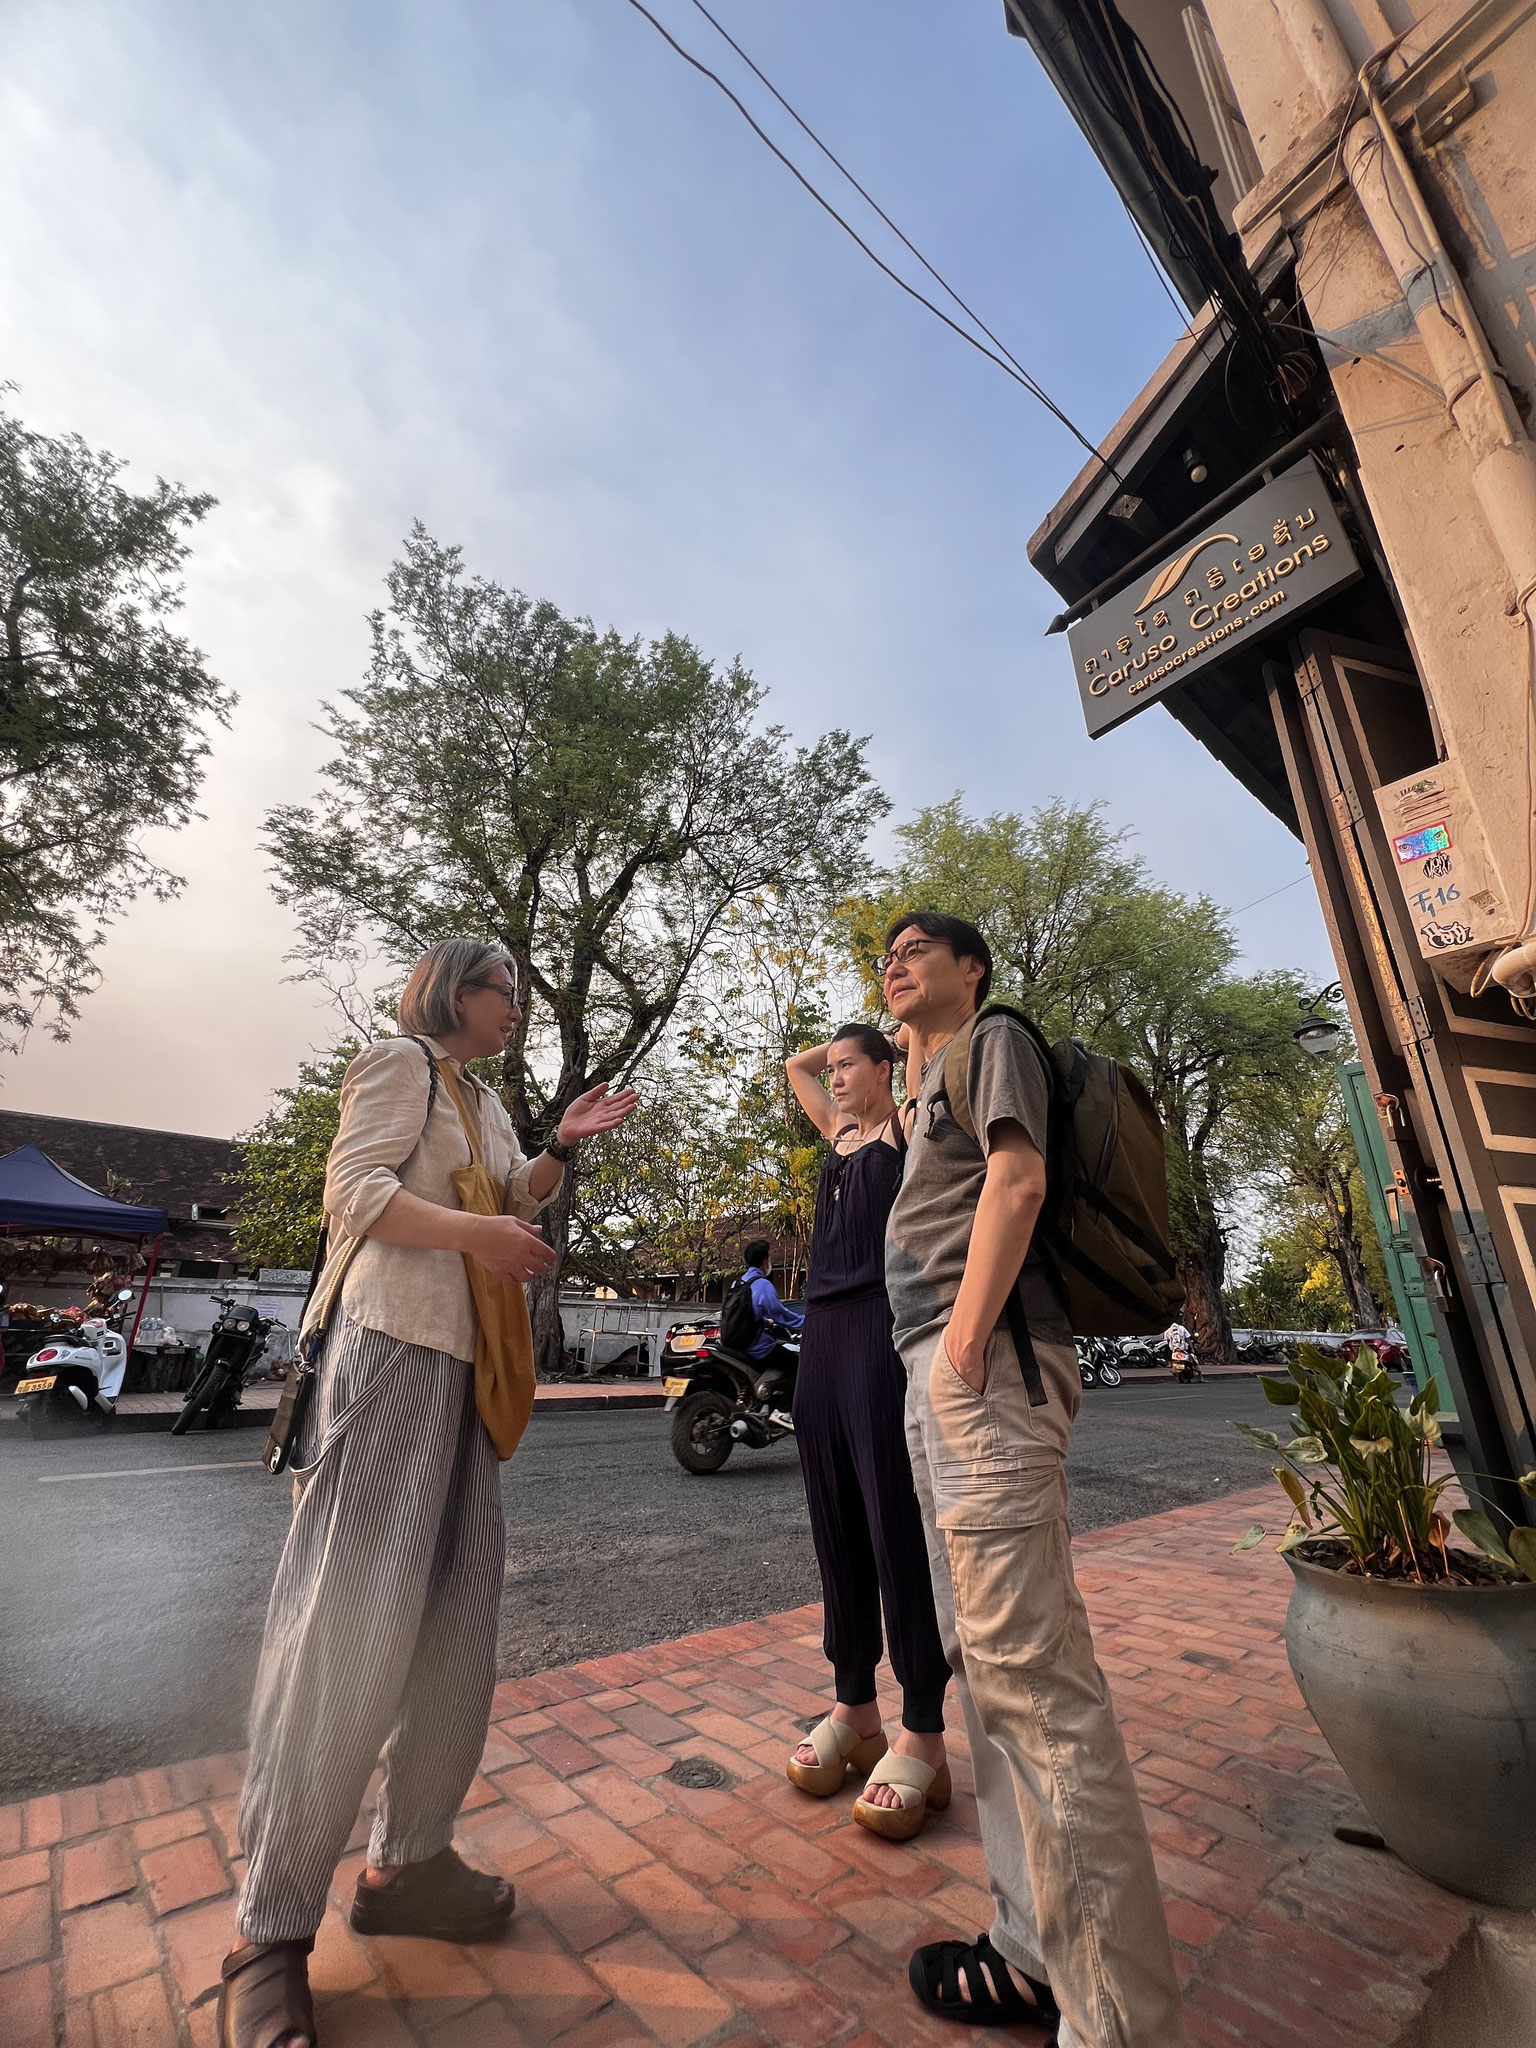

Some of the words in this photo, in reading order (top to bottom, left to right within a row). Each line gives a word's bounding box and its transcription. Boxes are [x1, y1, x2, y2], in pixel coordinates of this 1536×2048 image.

[1088, 634, 1177, 696] Caruso
[1189, 534, 1330, 631] Creations
[1128, 590, 1286, 695] carusocreations.com
